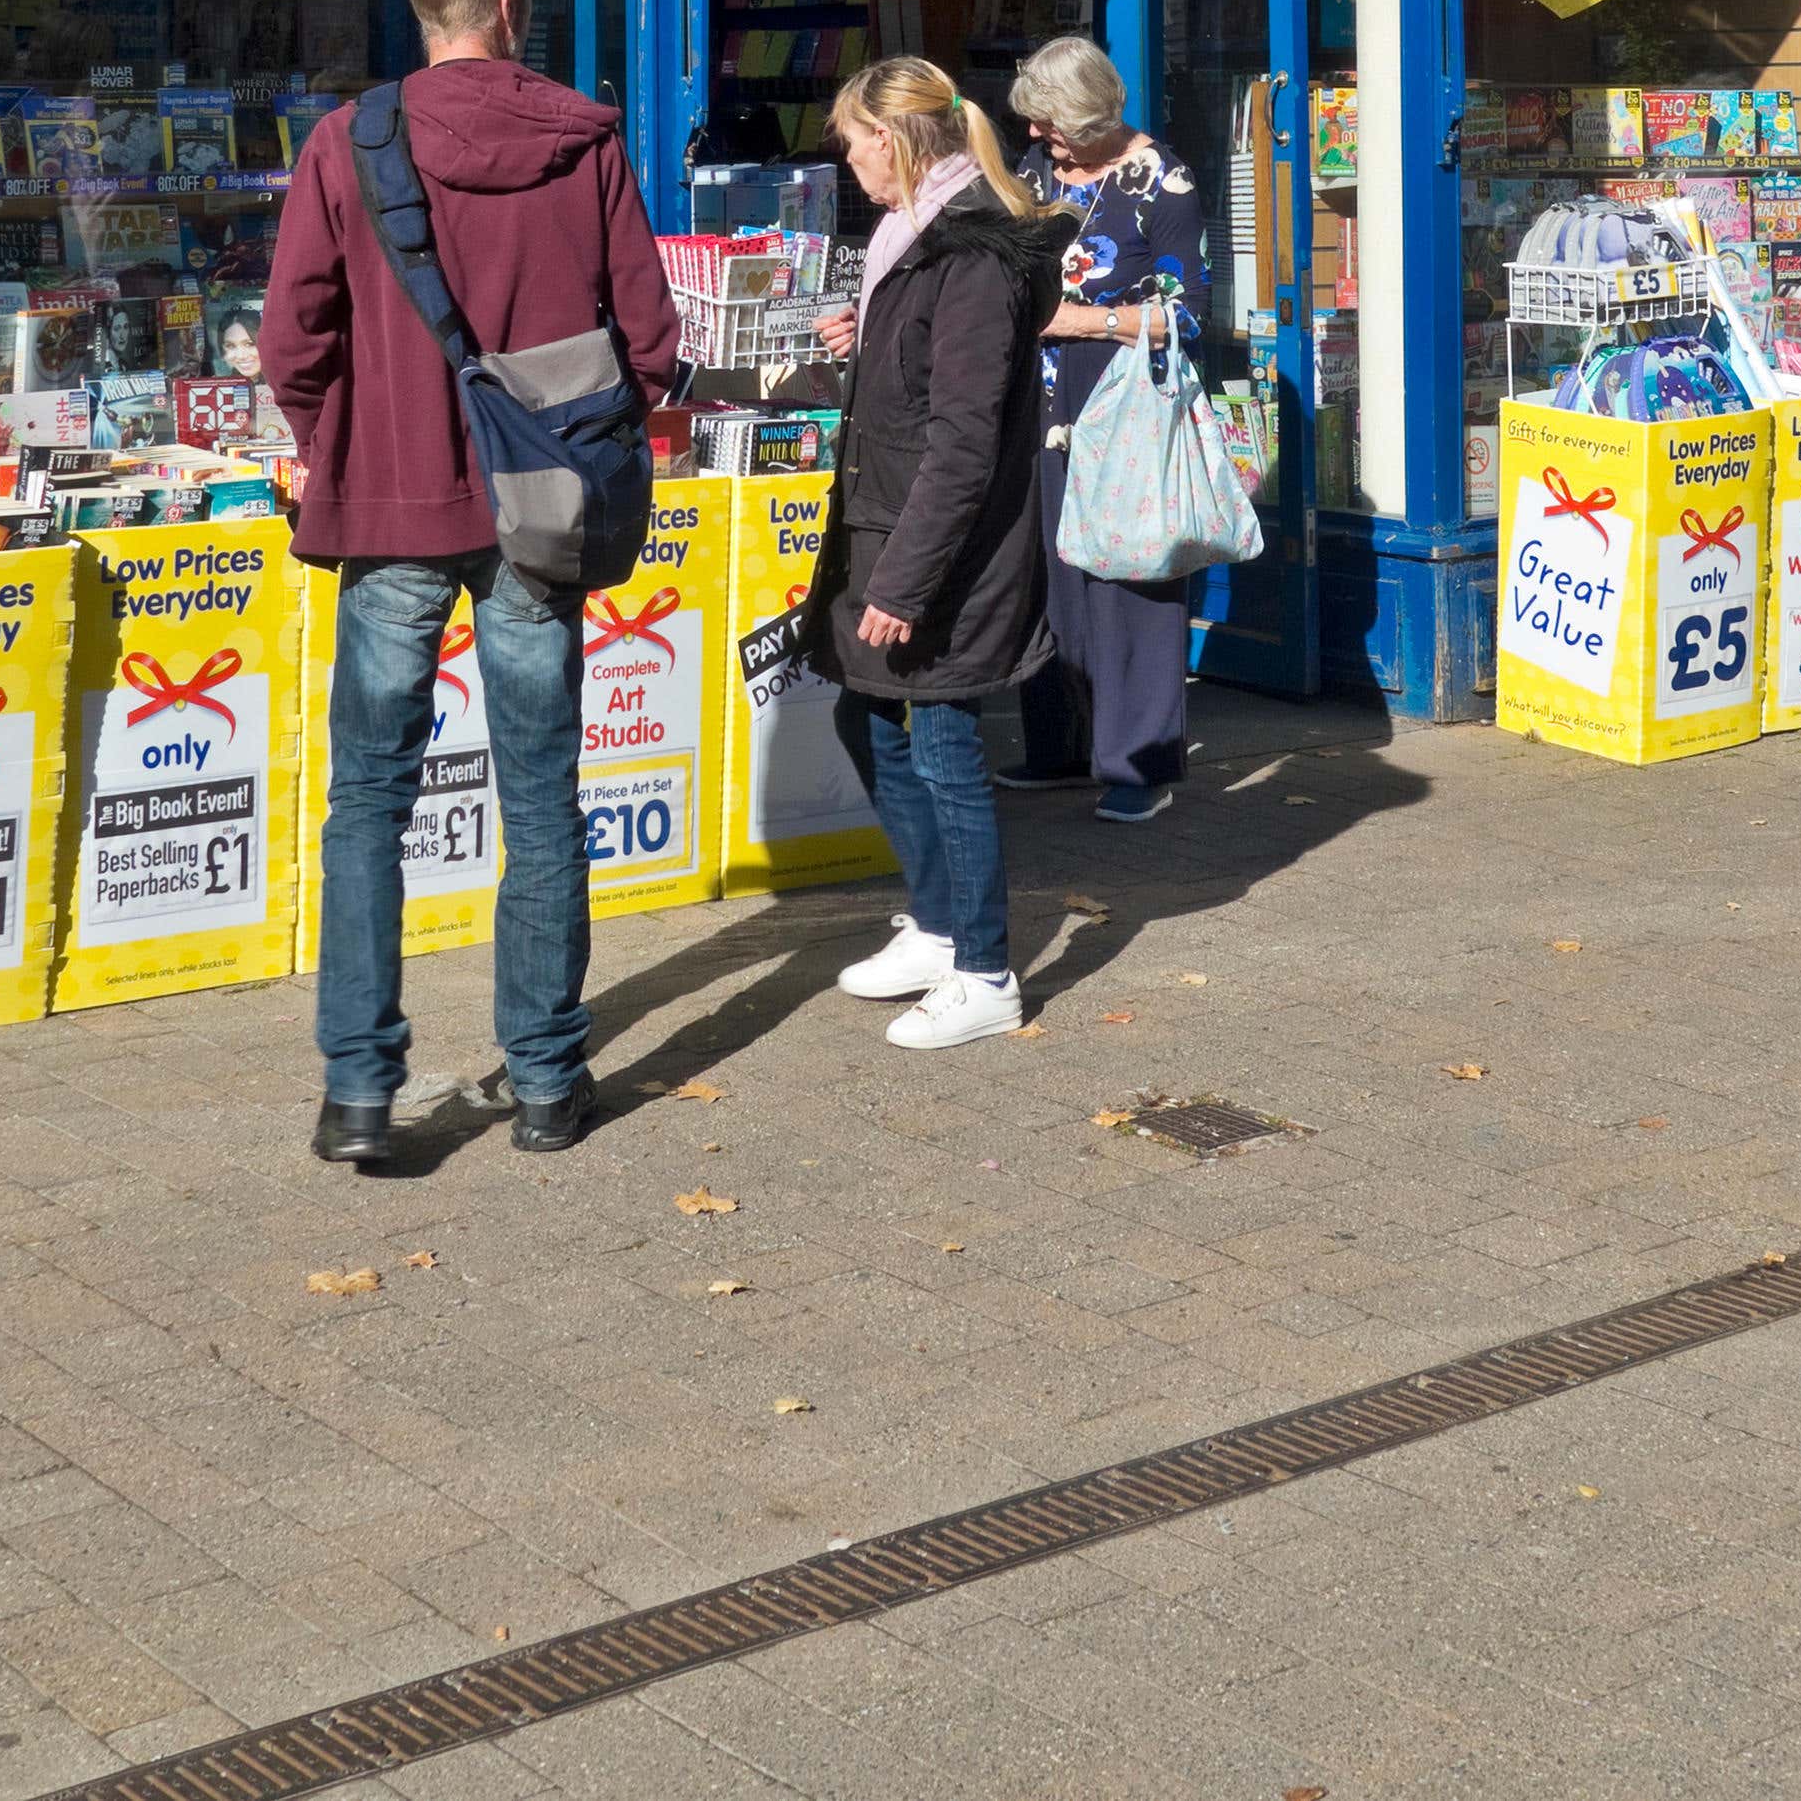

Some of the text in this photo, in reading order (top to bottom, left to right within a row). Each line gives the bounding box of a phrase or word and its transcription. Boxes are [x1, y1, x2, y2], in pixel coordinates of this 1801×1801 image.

[90, 65, 134, 77] LUNAR
[90, 76, 134, 88] ROVER
[1633, 268, 1660, 295] £5
[769, 291, 849, 310] ACADEMIC DIARIES
[796, 307, 823, 320] HALF
[769, 320, 813, 335] MARKED
[759, 443, 789, 461] NEVER
[1508, 420, 1631, 458] Gifts for everyone!
[770, 498, 821, 525] Low
[101, 544, 264, 585] Low Prices
[1690, 568, 1728, 593] only
[111, 581, 252, 621] Everyday
[1514, 586, 1603, 656] Value
[745, 626, 784, 668] PAY
[1668, 605, 1749, 690] £5
[592, 658, 662, 681] Complete
[607, 685, 646, 714] Art
[584, 718, 665, 752] Studio
[96, 840, 199, 875] Best Selling
[203, 832, 250, 897] £1
[96, 865, 200, 903] Paperbacks
